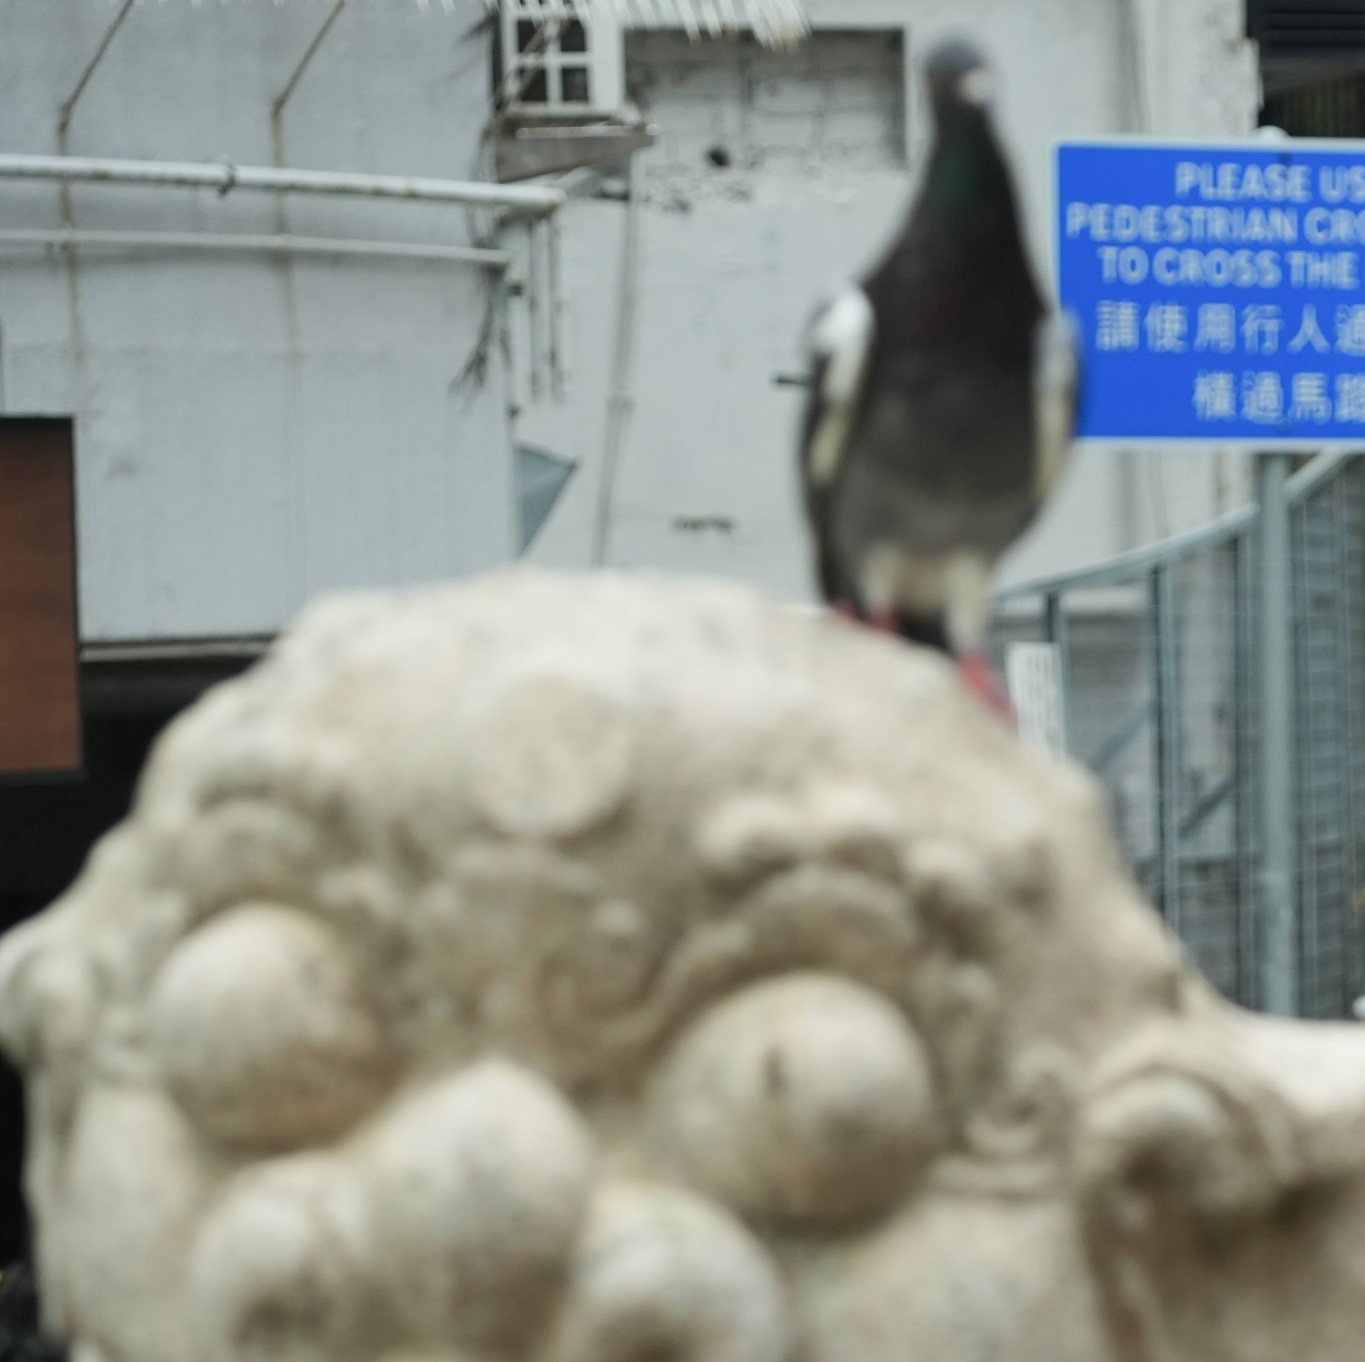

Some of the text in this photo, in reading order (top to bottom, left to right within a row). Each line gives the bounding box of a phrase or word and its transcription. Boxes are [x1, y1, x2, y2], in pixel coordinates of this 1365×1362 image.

[1174, 160, 1311, 202] PLEASE
[1066, 202, 1298, 244] PEDESTRIAN
[1096, 245, 1149, 285] TO
[1153, 247, 1282, 288] CROSS
[1286, 250, 1359, 289] THE
